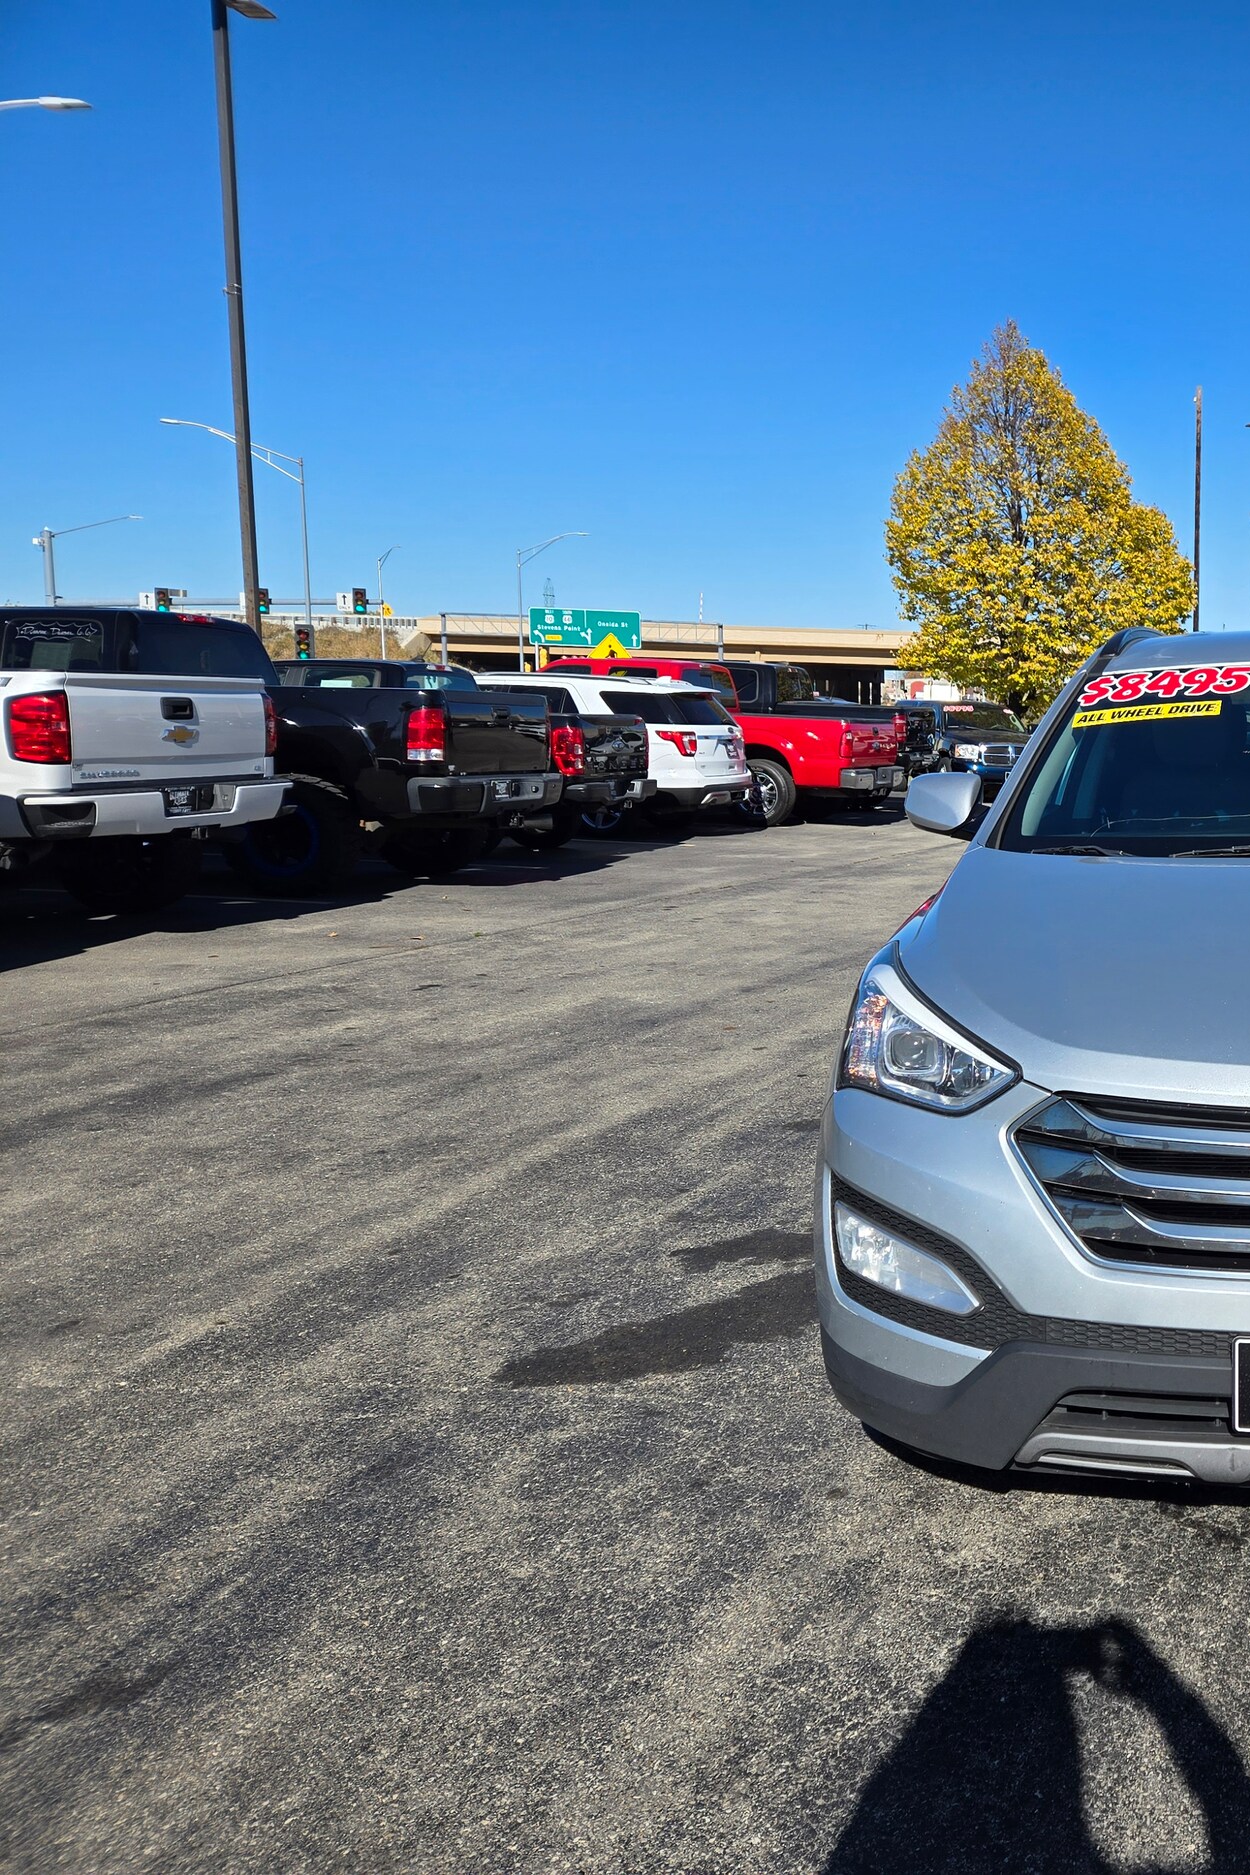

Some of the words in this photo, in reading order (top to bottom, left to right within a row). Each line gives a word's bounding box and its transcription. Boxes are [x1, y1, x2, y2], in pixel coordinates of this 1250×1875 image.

[597, 620, 619, 628] Oneida
[1077, 714, 1105, 724] ALL
[1110, 706, 1163, 720] WHEEL
[1167, 703, 1216, 715] DRIVE
